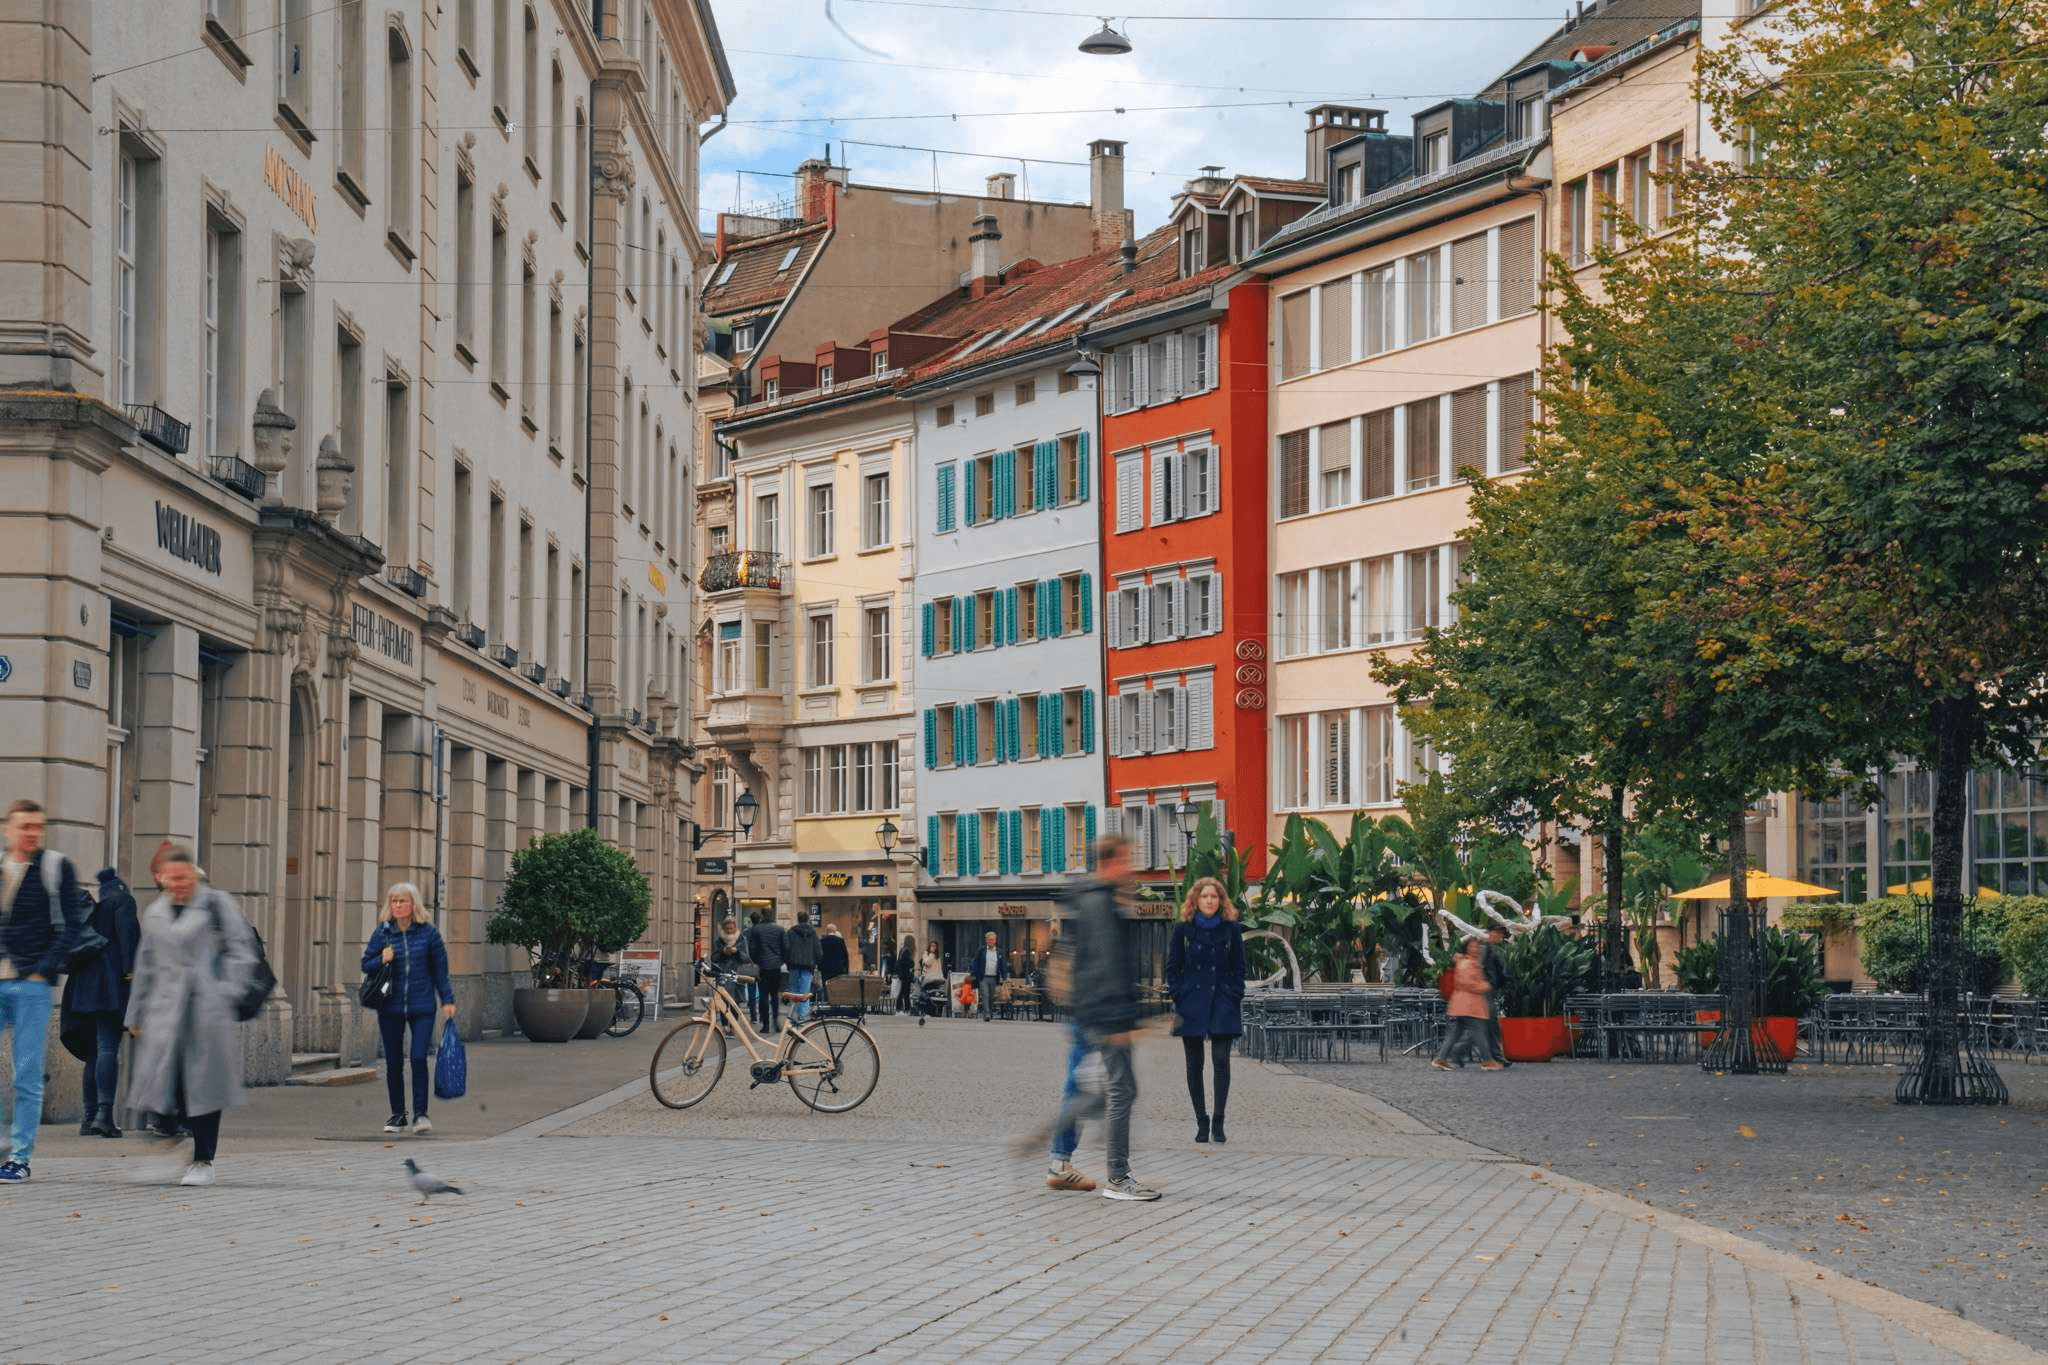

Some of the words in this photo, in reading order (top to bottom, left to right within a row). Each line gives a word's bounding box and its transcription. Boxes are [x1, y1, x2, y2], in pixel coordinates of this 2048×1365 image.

[264, 143, 317, 236] AMTSHAUS
[155, 499, 222, 577] WELLAUER
[1330, 722, 1338, 753] LINEA
[1330, 758, 1338, 796] NUOVA
